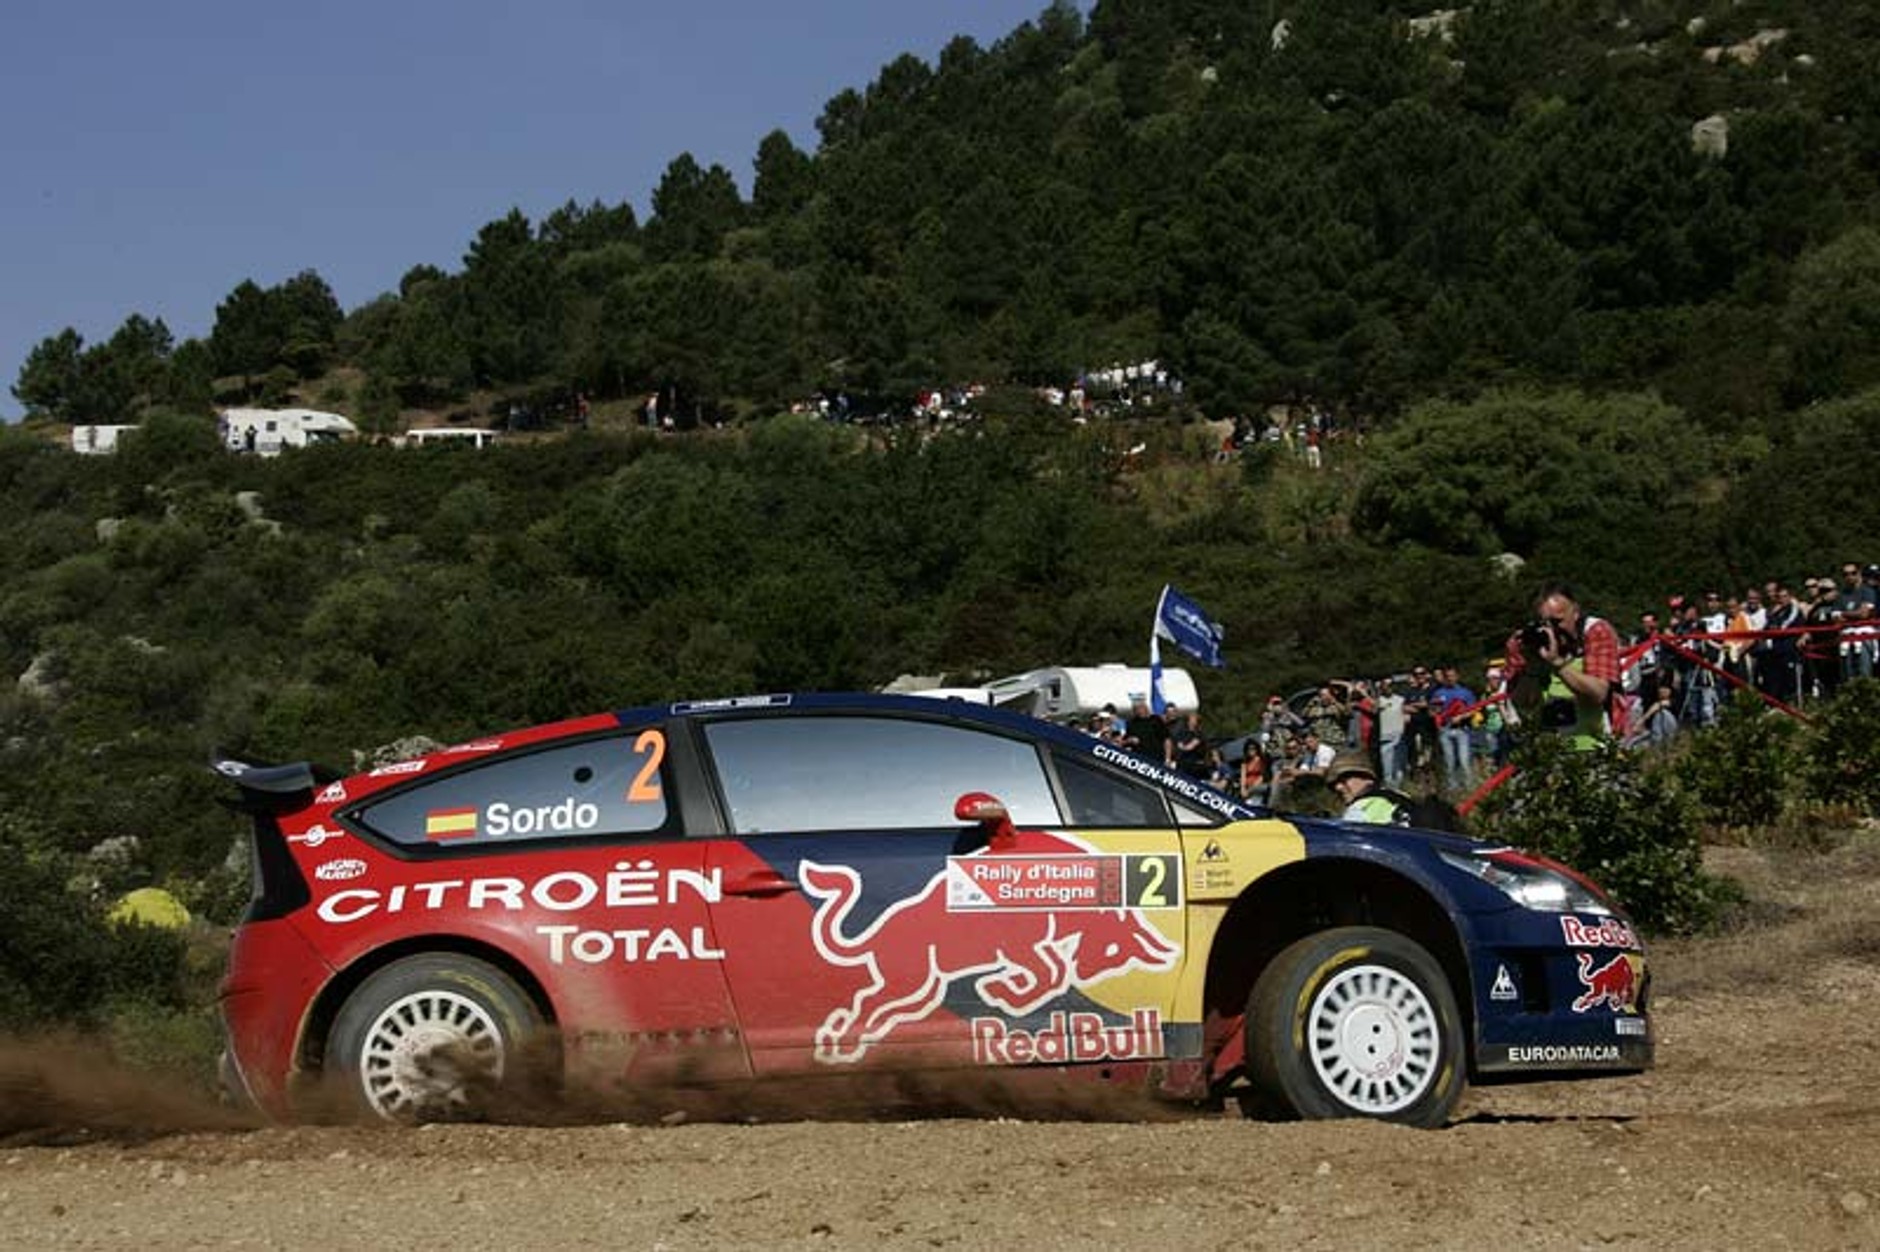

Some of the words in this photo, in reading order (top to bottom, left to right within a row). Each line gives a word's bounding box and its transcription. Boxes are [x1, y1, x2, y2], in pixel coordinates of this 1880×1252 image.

[627, 729, 666, 803] 2
[485, 797, 600, 835] Sordo
[316, 860, 723, 923] CITROËN
[973, 864, 1021, 883] Rally
[1027, 863, 1095, 880] d'Italia
[998, 884, 1096, 903] Sardegna
[1139, 857, 1167, 906] 2
[971, 1012, 1068, 1066] Red
[1070, 1008, 1165, 1061] Bull
[1507, 1045, 1621, 1061] EURODATACAR
